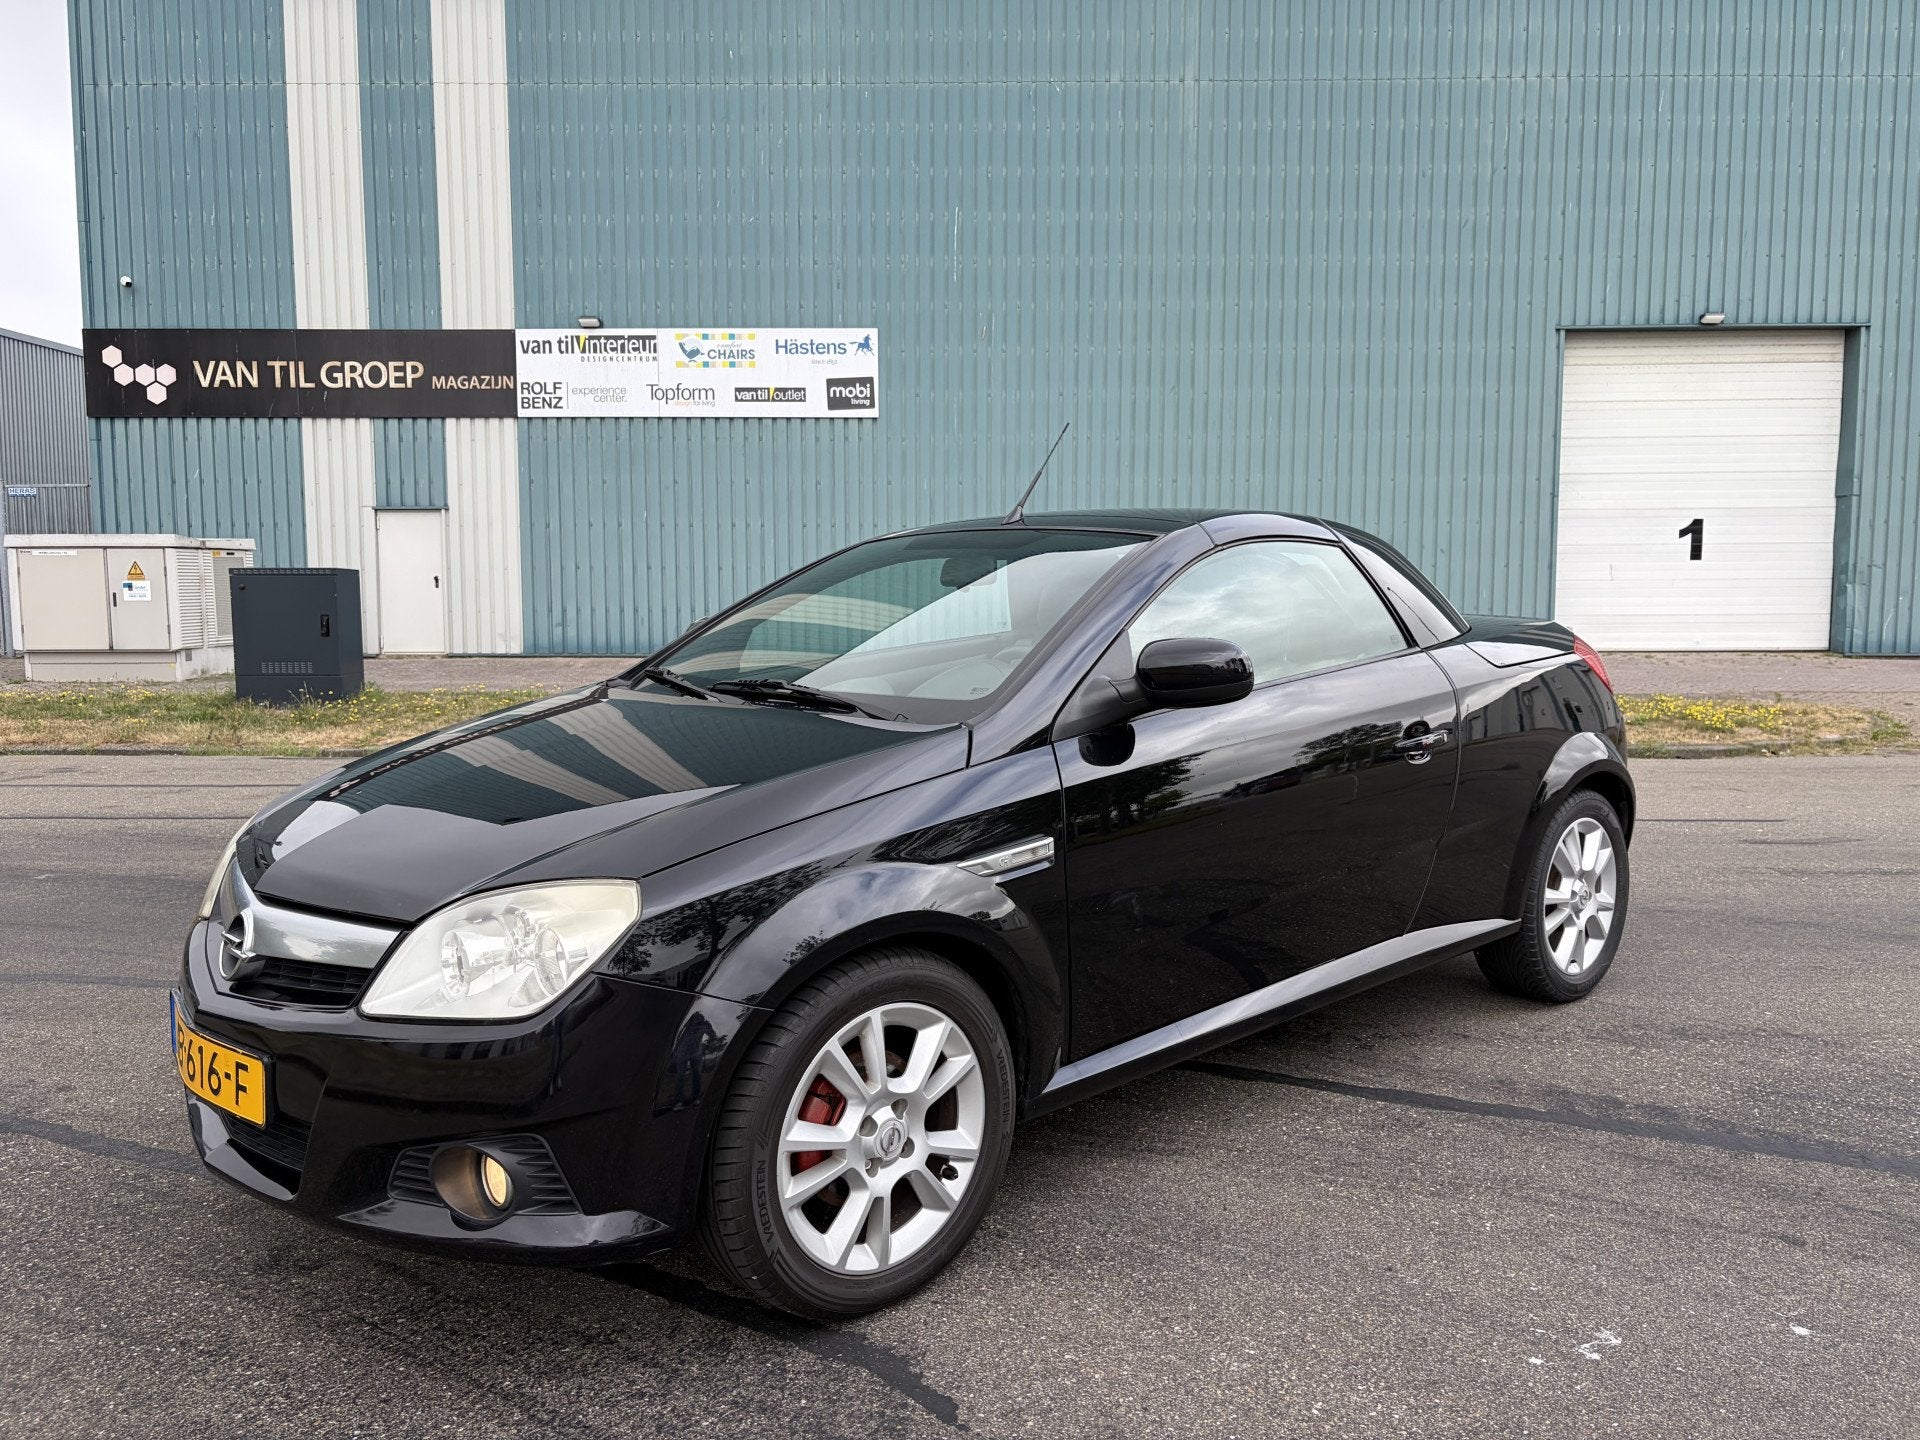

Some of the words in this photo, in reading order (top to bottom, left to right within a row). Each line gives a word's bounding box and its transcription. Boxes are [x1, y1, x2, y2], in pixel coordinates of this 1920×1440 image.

[520, 339, 552, 354] van
[557, 335, 574, 354] til
[775, 339, 847, 355] Hästens
[707, 349, 755, 360] CHAIRS
[193, 360, 259, 389] VAN
[267, 360, 316, 389] TIL
[320, 360, 425, 389] GROEP
[431, 375, 514, 390] MAGAZIJN
[520, 382, 562, 395] ROLF
[571, 386, 627, 397] experience
[646, 383, 716, 405] Topform
[736, 390, 756, 400] van
[757, 389, 768, 400] til
[774, 389, 805, 400] outlet
[829, 383, 871, 398] mobi
[521, 397, 563, 410] BENZ
[851, 398, 871, 406] living
[1679, 518, 1704, 561] 1
[996, 1047, 1011, 1123] VREDESTEIN
[756, 1159, 775, 1244] VREDESTEIN
